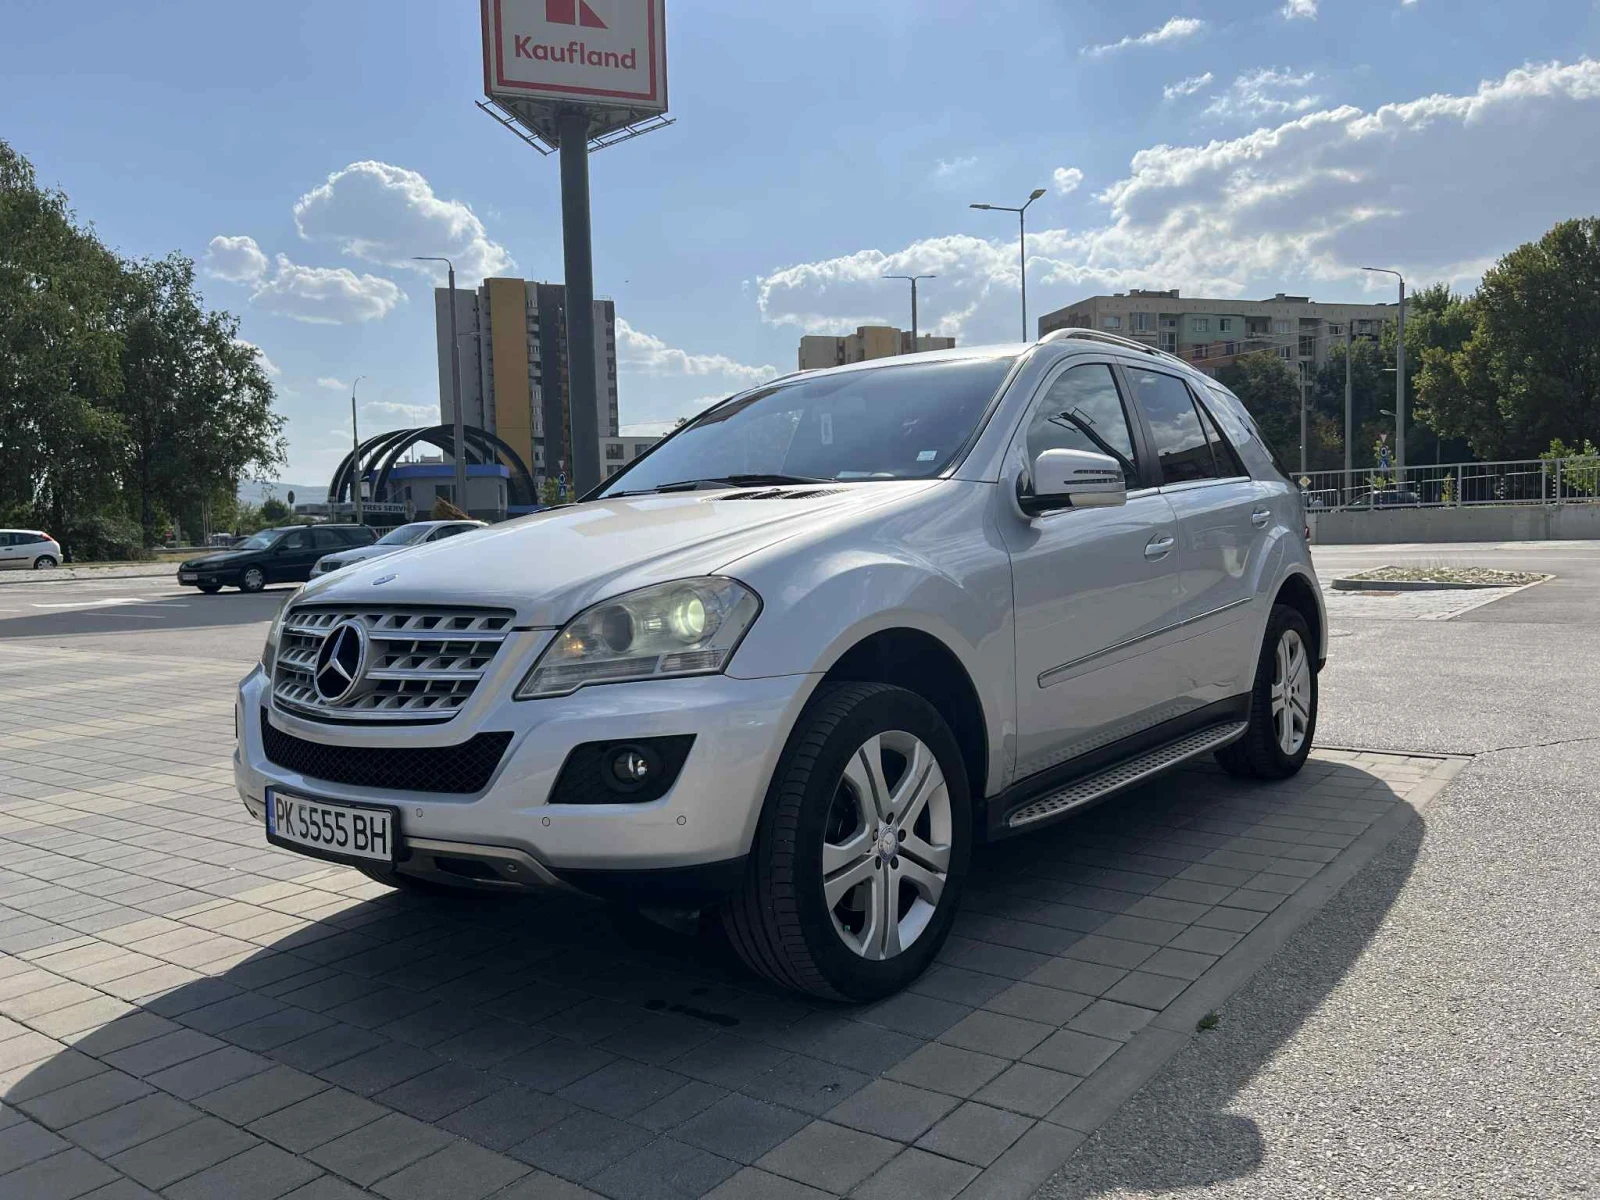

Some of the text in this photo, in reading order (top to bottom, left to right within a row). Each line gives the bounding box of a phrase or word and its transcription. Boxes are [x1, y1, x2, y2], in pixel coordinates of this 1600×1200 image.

[514, 34, 636, 70] Kaufland
[276, 797, 387, 855] PK 5555 BH
